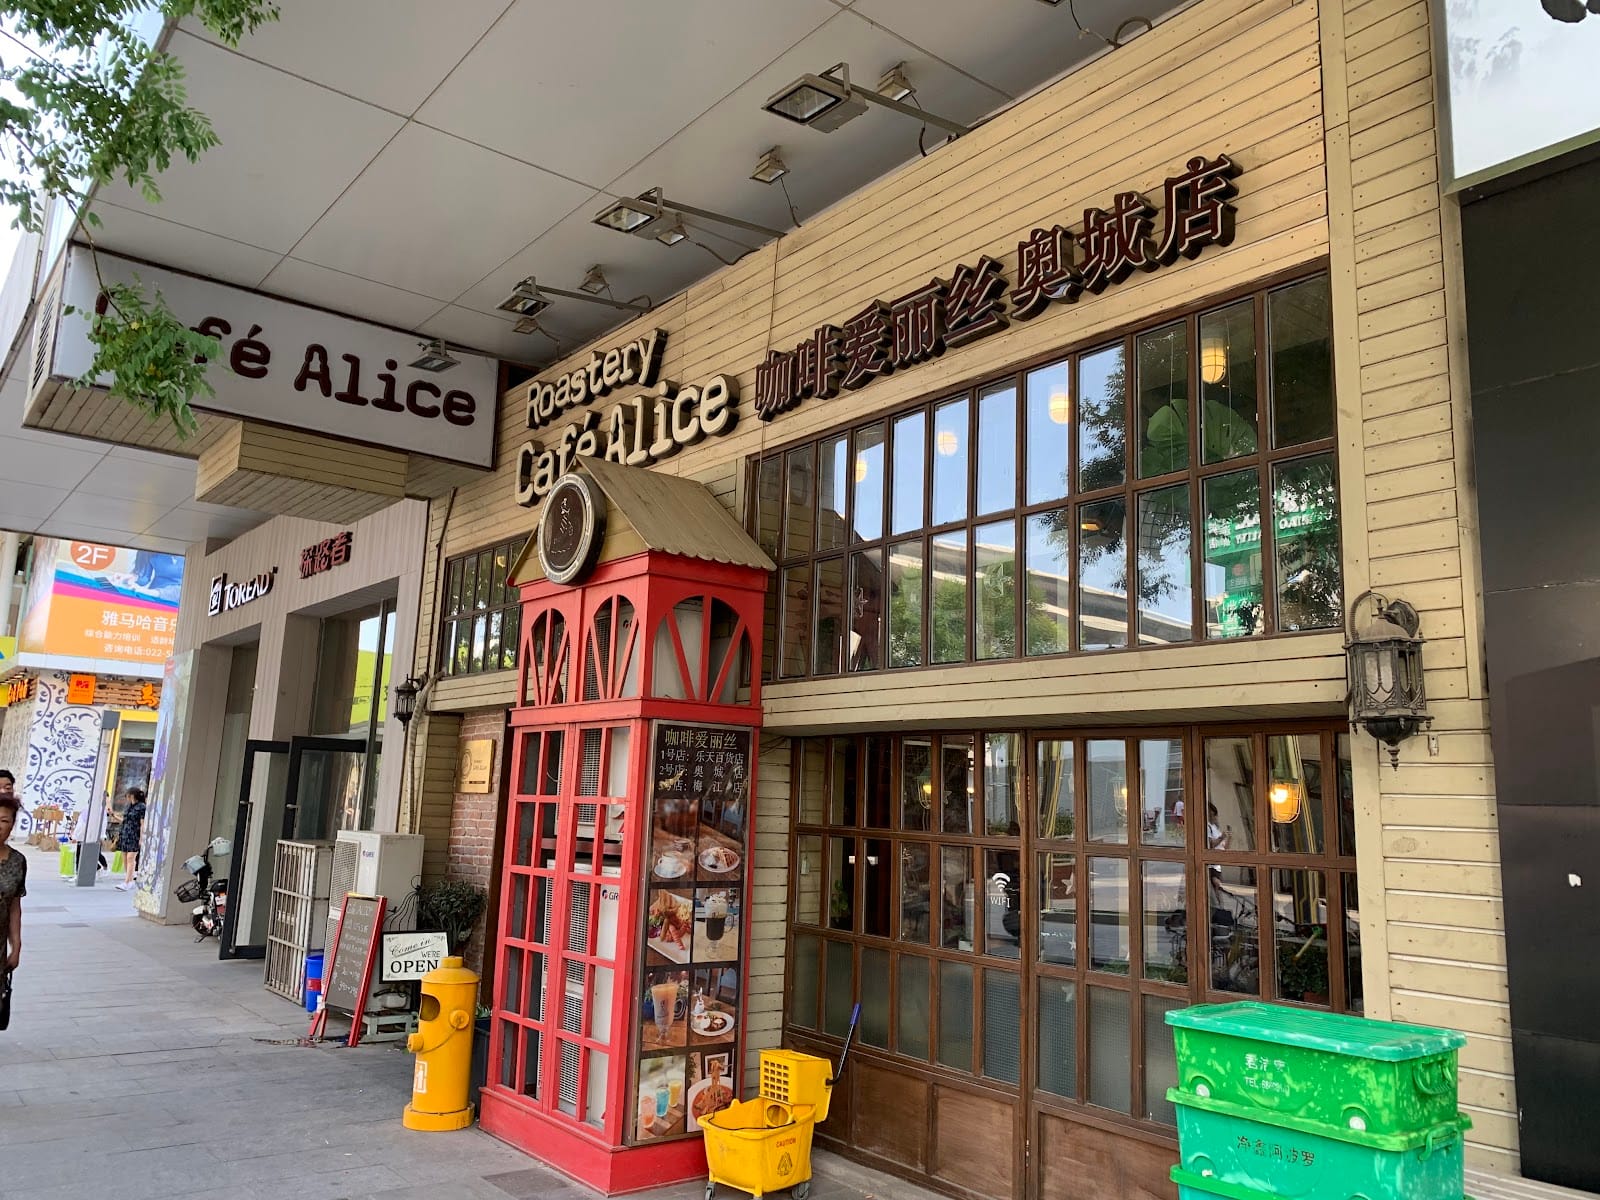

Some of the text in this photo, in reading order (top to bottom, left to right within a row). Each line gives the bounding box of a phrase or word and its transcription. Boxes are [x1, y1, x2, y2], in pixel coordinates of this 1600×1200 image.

[755, 153, 1240, 421] 咖啡爱丽丝奥城店
[95, 289, 476, 427] fé Alice
[525, 328, 665, 428] Roastery
[514, 374, 737, 505] Café Alice
[76, 545, 109, 565] 2F
[224, 572, 274, 611] TOREAD
[665, 729, 737, 749] 咖啡爱丽丝
[990, 896, 1010, 908] WIFI
[390, 960, 439, 974] OPEN
